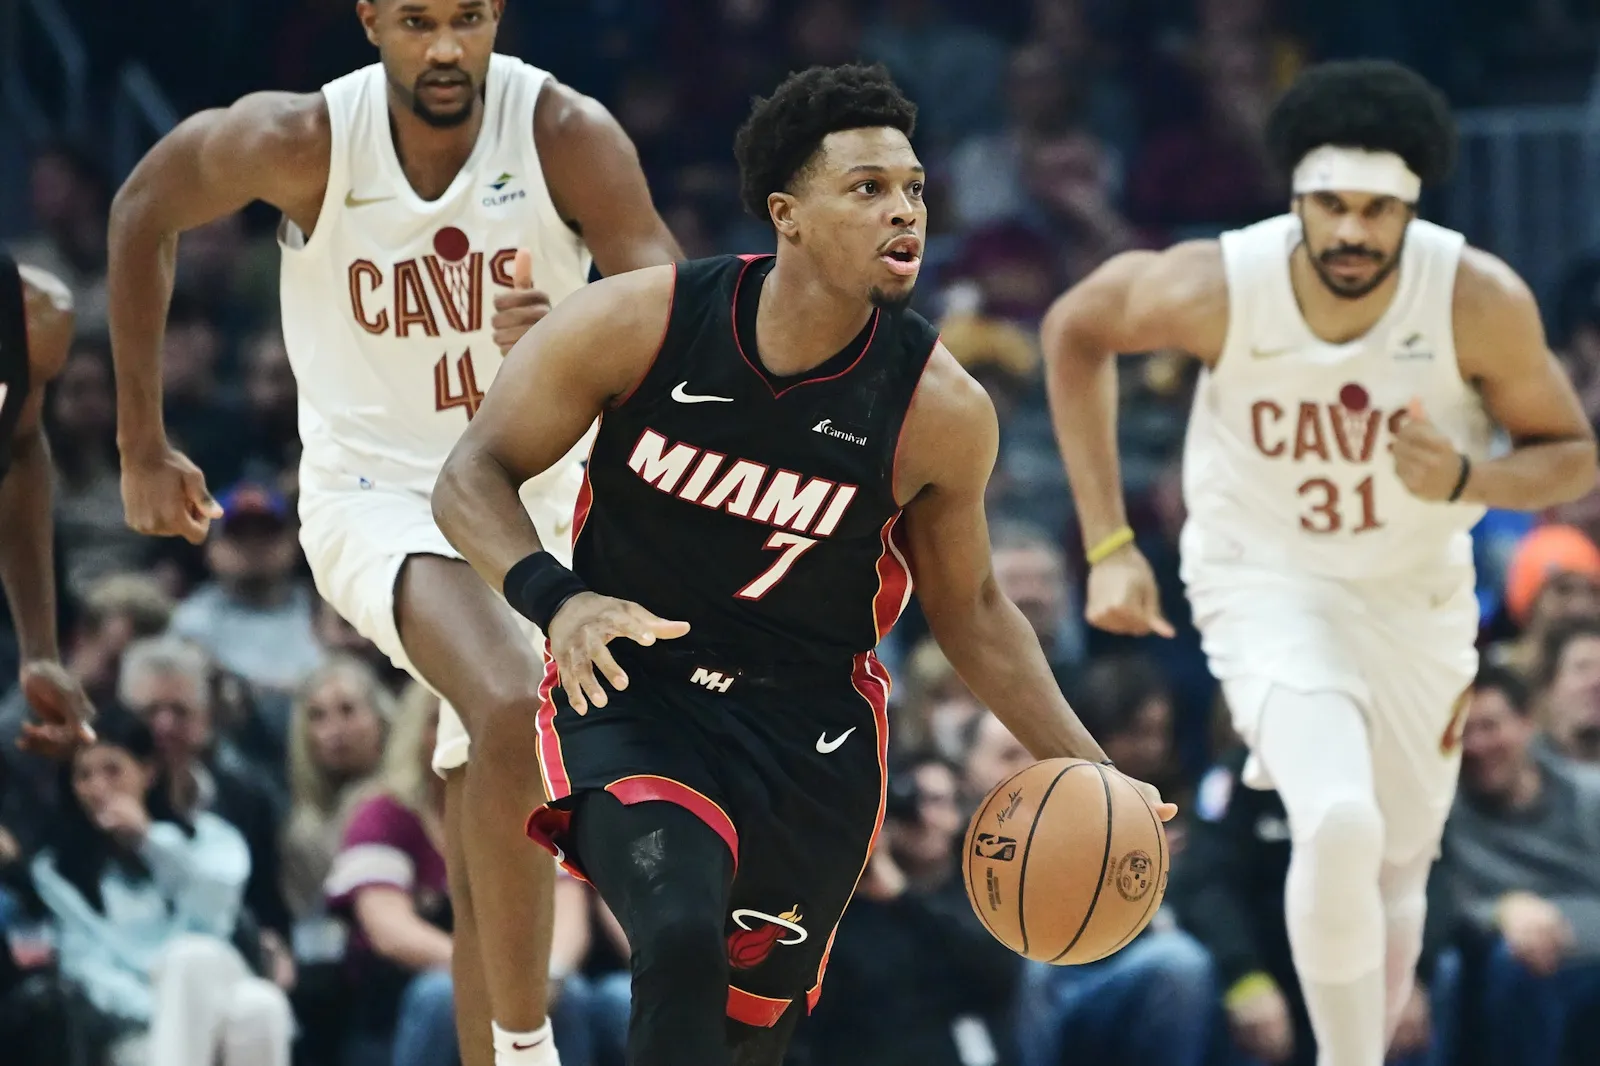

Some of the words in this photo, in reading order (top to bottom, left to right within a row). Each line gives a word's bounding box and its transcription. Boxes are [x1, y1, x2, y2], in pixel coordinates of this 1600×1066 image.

[482, 189, 526, 207] CLIFFS
[434, 346, 486, 423] 4
[823, 425, 868, 447] Carnival
[627, 426, 859, 537] MIAMI
[1296, 474, 1386, 535] 31
[732, 529, 820, 601] 7
[689, 666, 735, 693] MH
